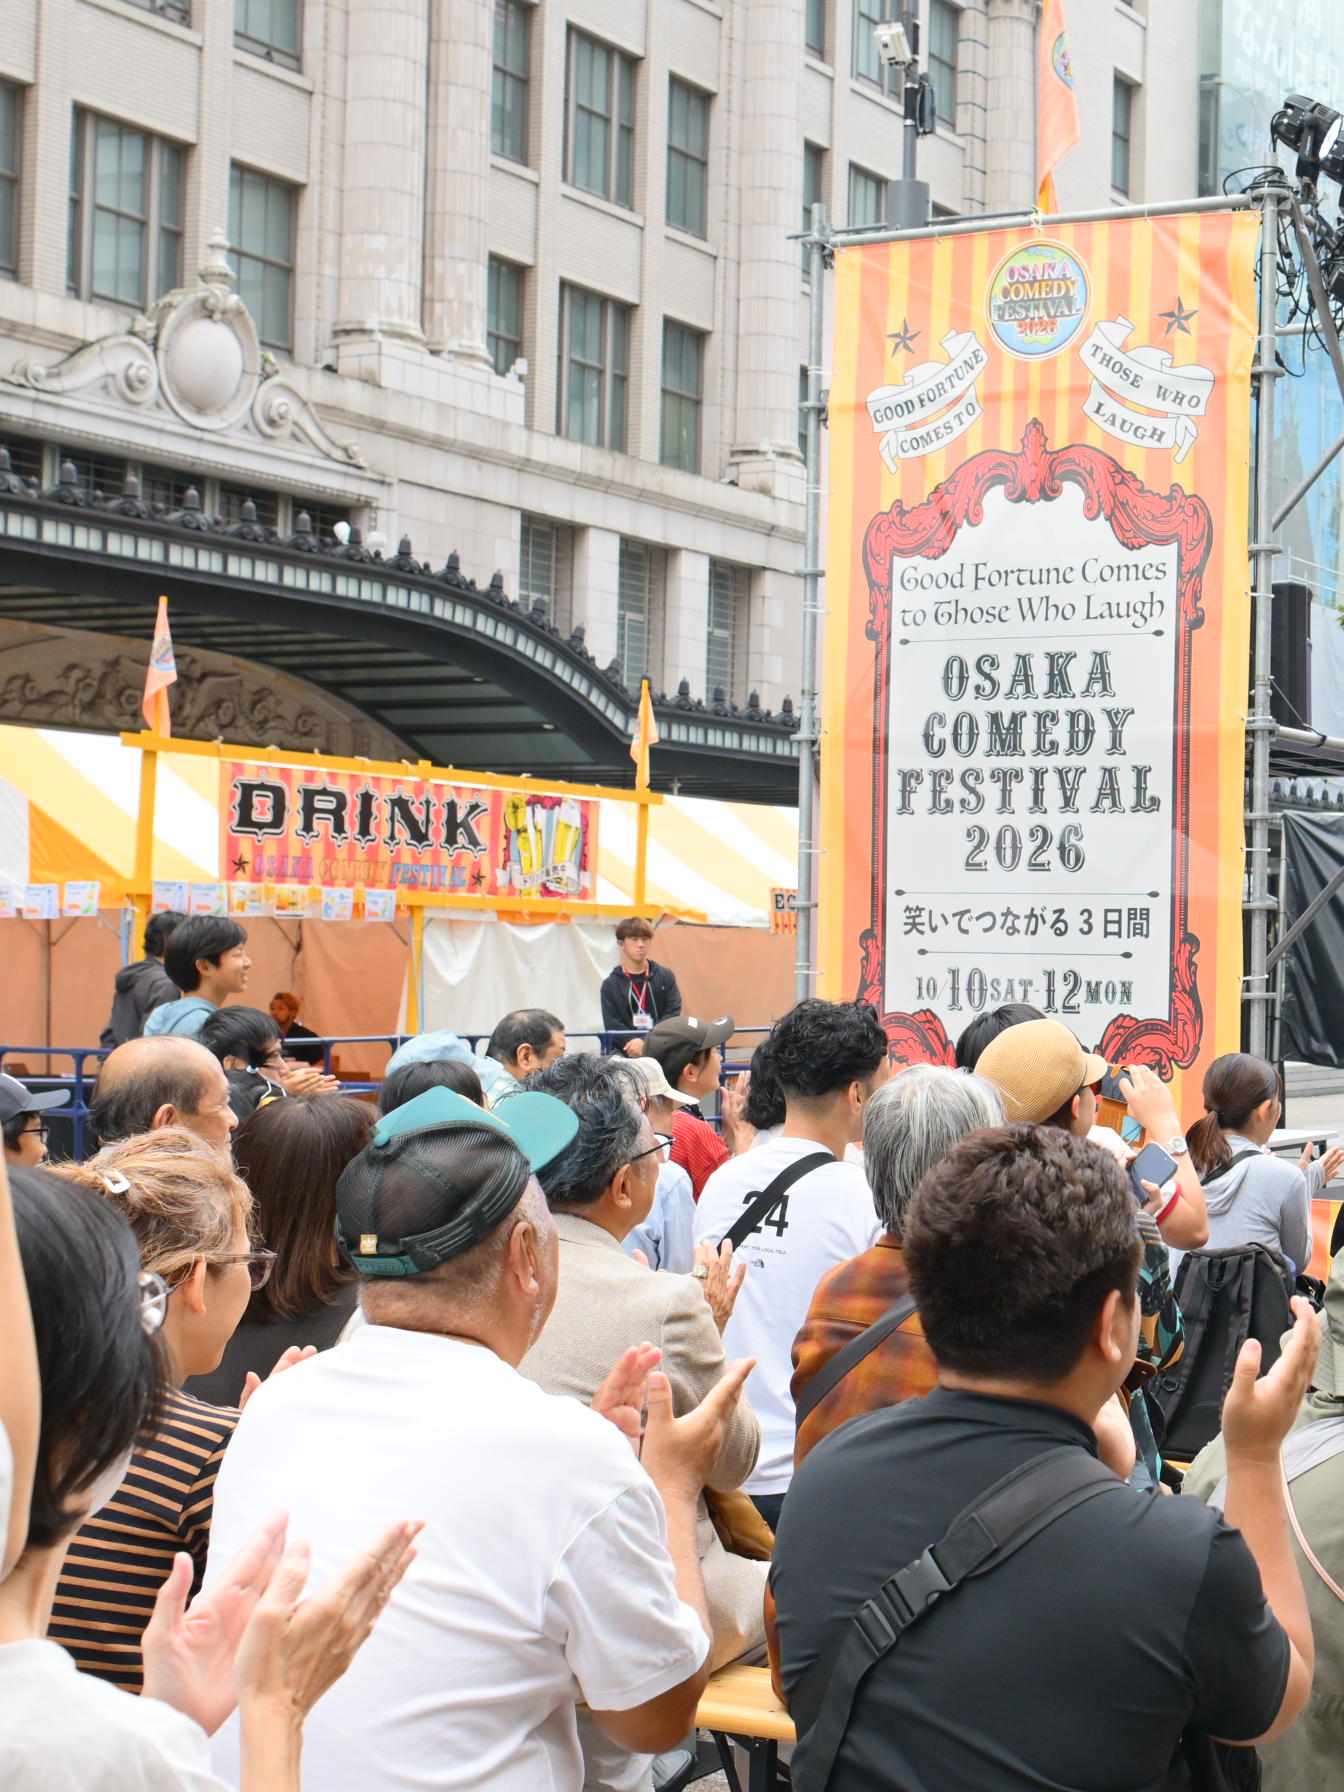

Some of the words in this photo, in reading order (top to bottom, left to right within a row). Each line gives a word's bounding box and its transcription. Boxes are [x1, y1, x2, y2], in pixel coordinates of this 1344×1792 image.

[998, 278, 1081, 302] COMEDY
[1005, 260, 1073, 283] OSAKA
[991, 298, 1084, 322] FESTIVAL
[1015, 317, 1059, 338] 2026
[873, 399, 915, 424] GOOD
[916, 348, 984, 409] FORTUNE
[1090, 343, 1144, 389] THOSE
[1155, 384, 1201, 418] WHO
[899, 421, 954, 454] COMES
[953, 401, 976, 426] TO
[1093, 401, 1167, 443] LAUGH
[899, 563, 965, 592] Good
[970, 560, 1075, 593] Fortune
[1081, 555, 1167, 587] Comes
[900, 606, 927, 628] to
[934, 598, 1011, 627] Those
[1017, 595, 1077, 625] Who
[1081, 591, 1165, 629] Laugh
[941, 650, 1116, 701] OSAKA
[921, 706, 1135, 758] COMEDY
[896, 764, 1161, 816] FESTIVAL
[229, 770, 489, 859] DRINK
[964, 822, 1086, 873] 2026
[254, 854, 314, 879] OSAKA
[390, 861, 468, 889] FESTIVAL
[902, 903, 1152, 940] 笑いでつながる3日間
